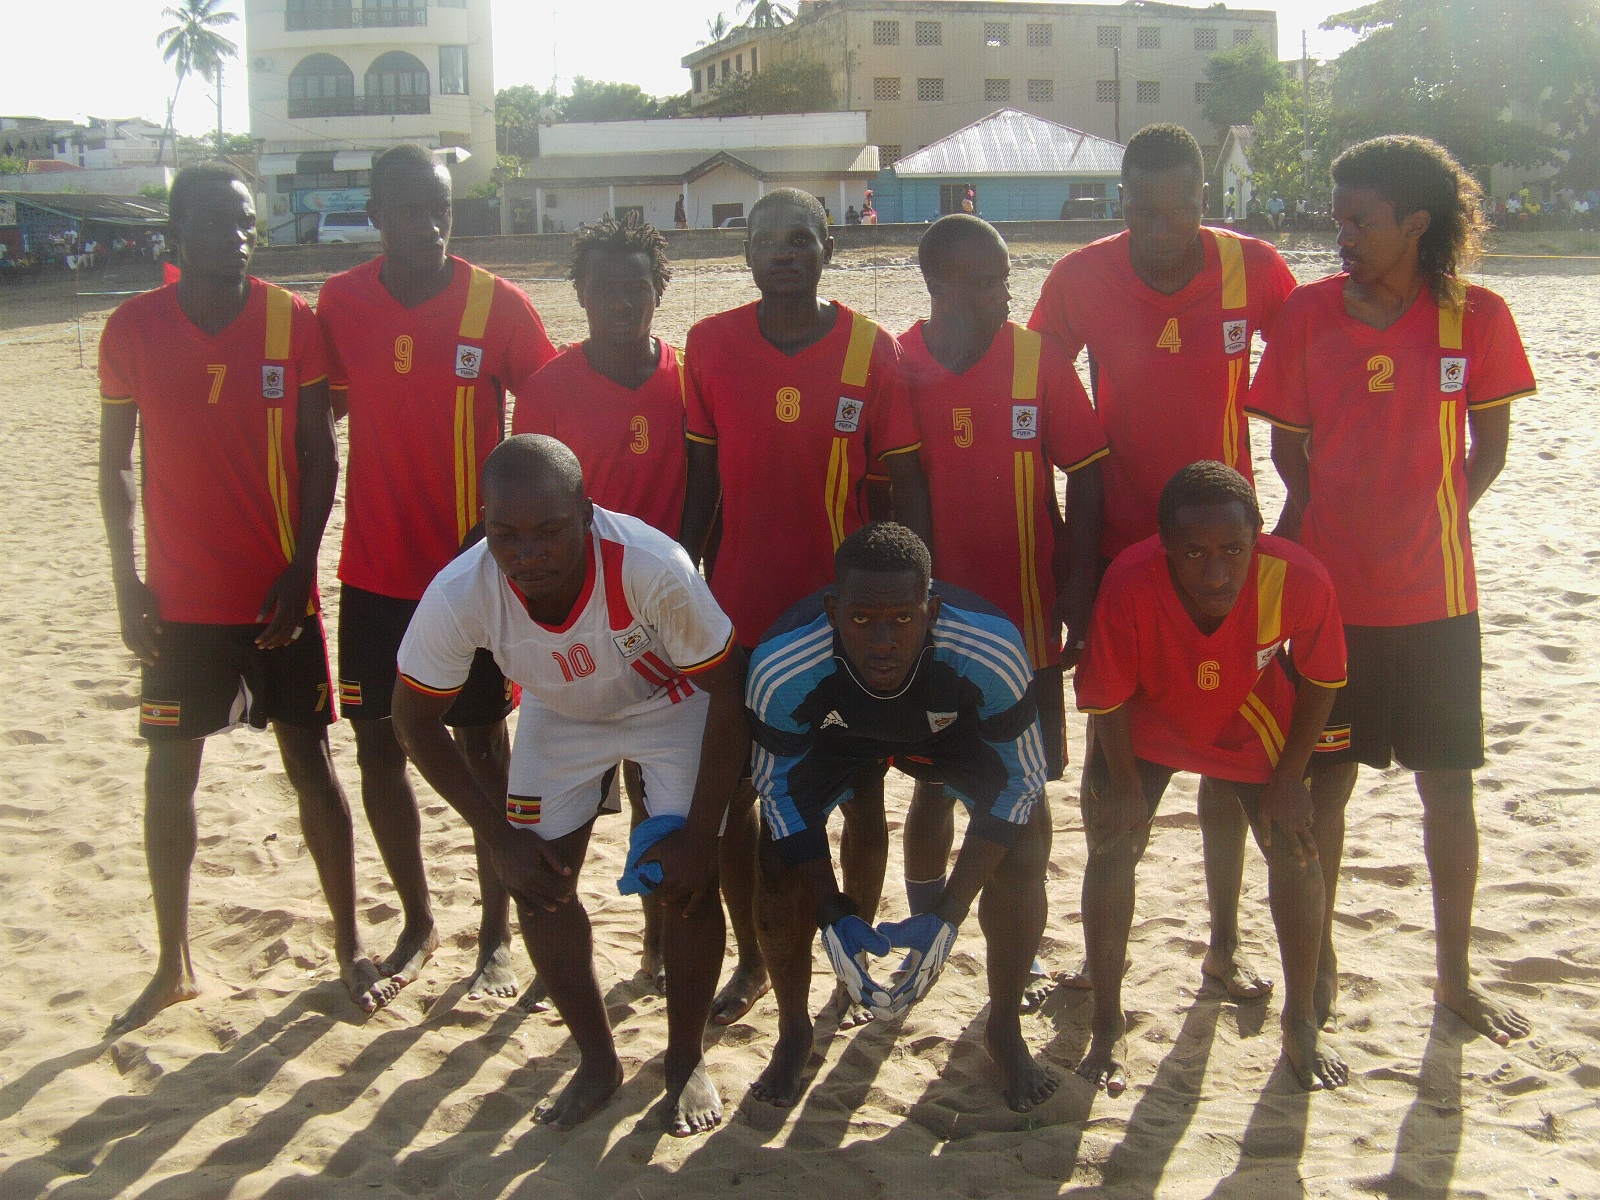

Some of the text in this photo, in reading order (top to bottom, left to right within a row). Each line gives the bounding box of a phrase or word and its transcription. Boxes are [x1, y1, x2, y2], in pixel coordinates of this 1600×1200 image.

[395, 334, 413, 374] 9
[1156, 318, 1181, 353] 4
[207, 364, 226, 404] 7
[1367, 355, 1394, 392] 2
[776, 386, 801, 422] 8
[630, 415, 649, 454] 3
[952, 408, 973, 448] 5
[552, 643, 596, 682] 10
[1198, 660, 1219, 690] 6
[315, 683, 328, 711] 7
[819, 719, 849, 730] adidas
